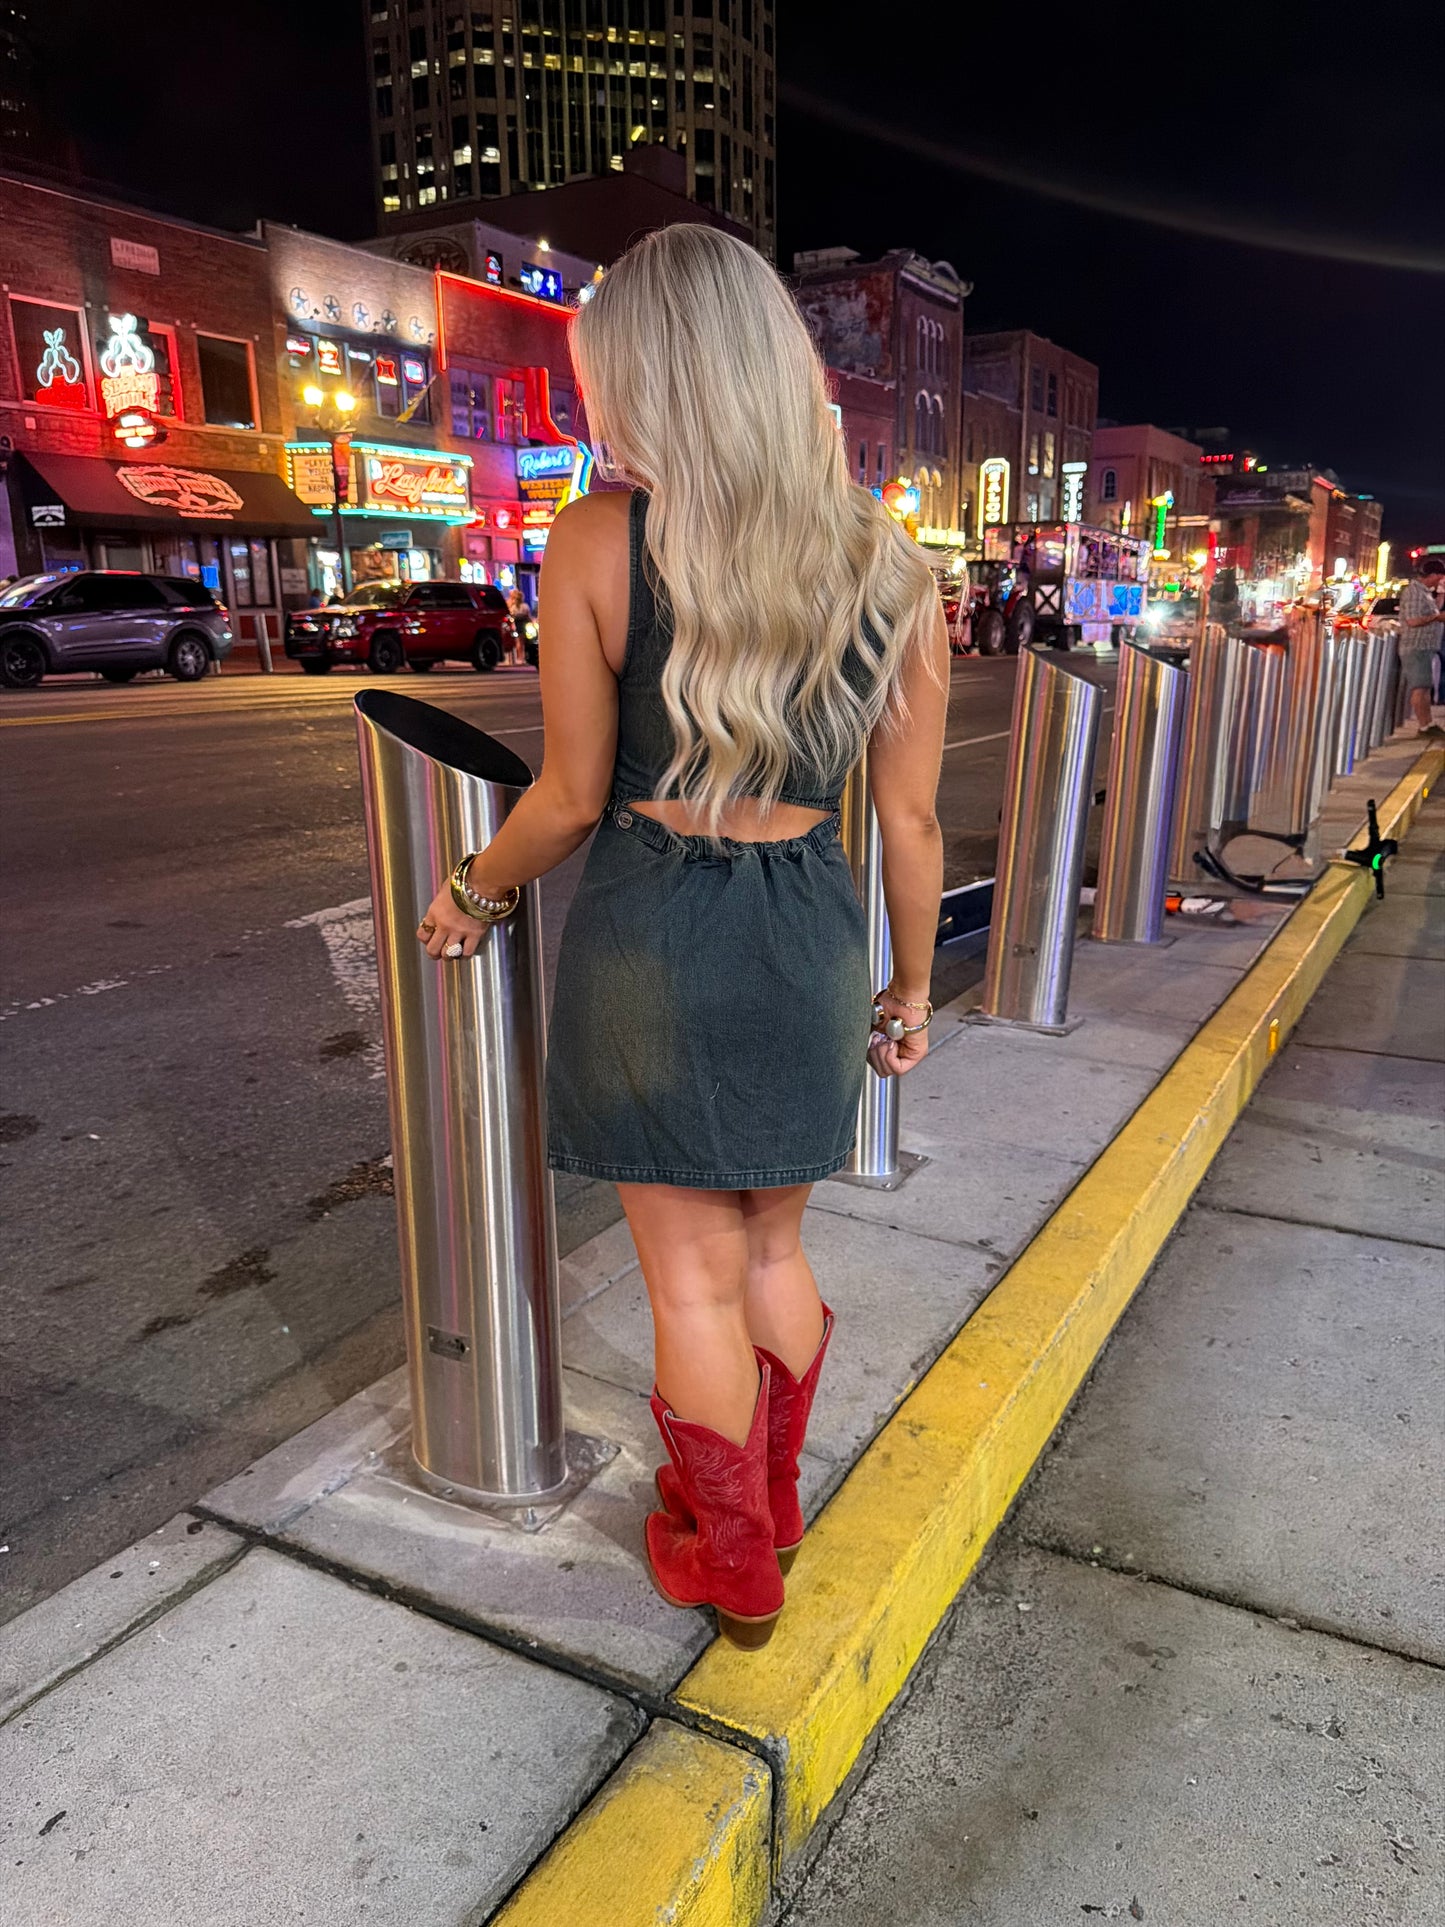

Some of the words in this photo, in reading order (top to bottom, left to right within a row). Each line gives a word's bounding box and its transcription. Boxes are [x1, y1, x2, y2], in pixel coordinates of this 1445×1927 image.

[374, 463, 465, 503] Layla's
[520, 447, 571, 479] Robert's
[985, 471, 1001, 523] SALOO
